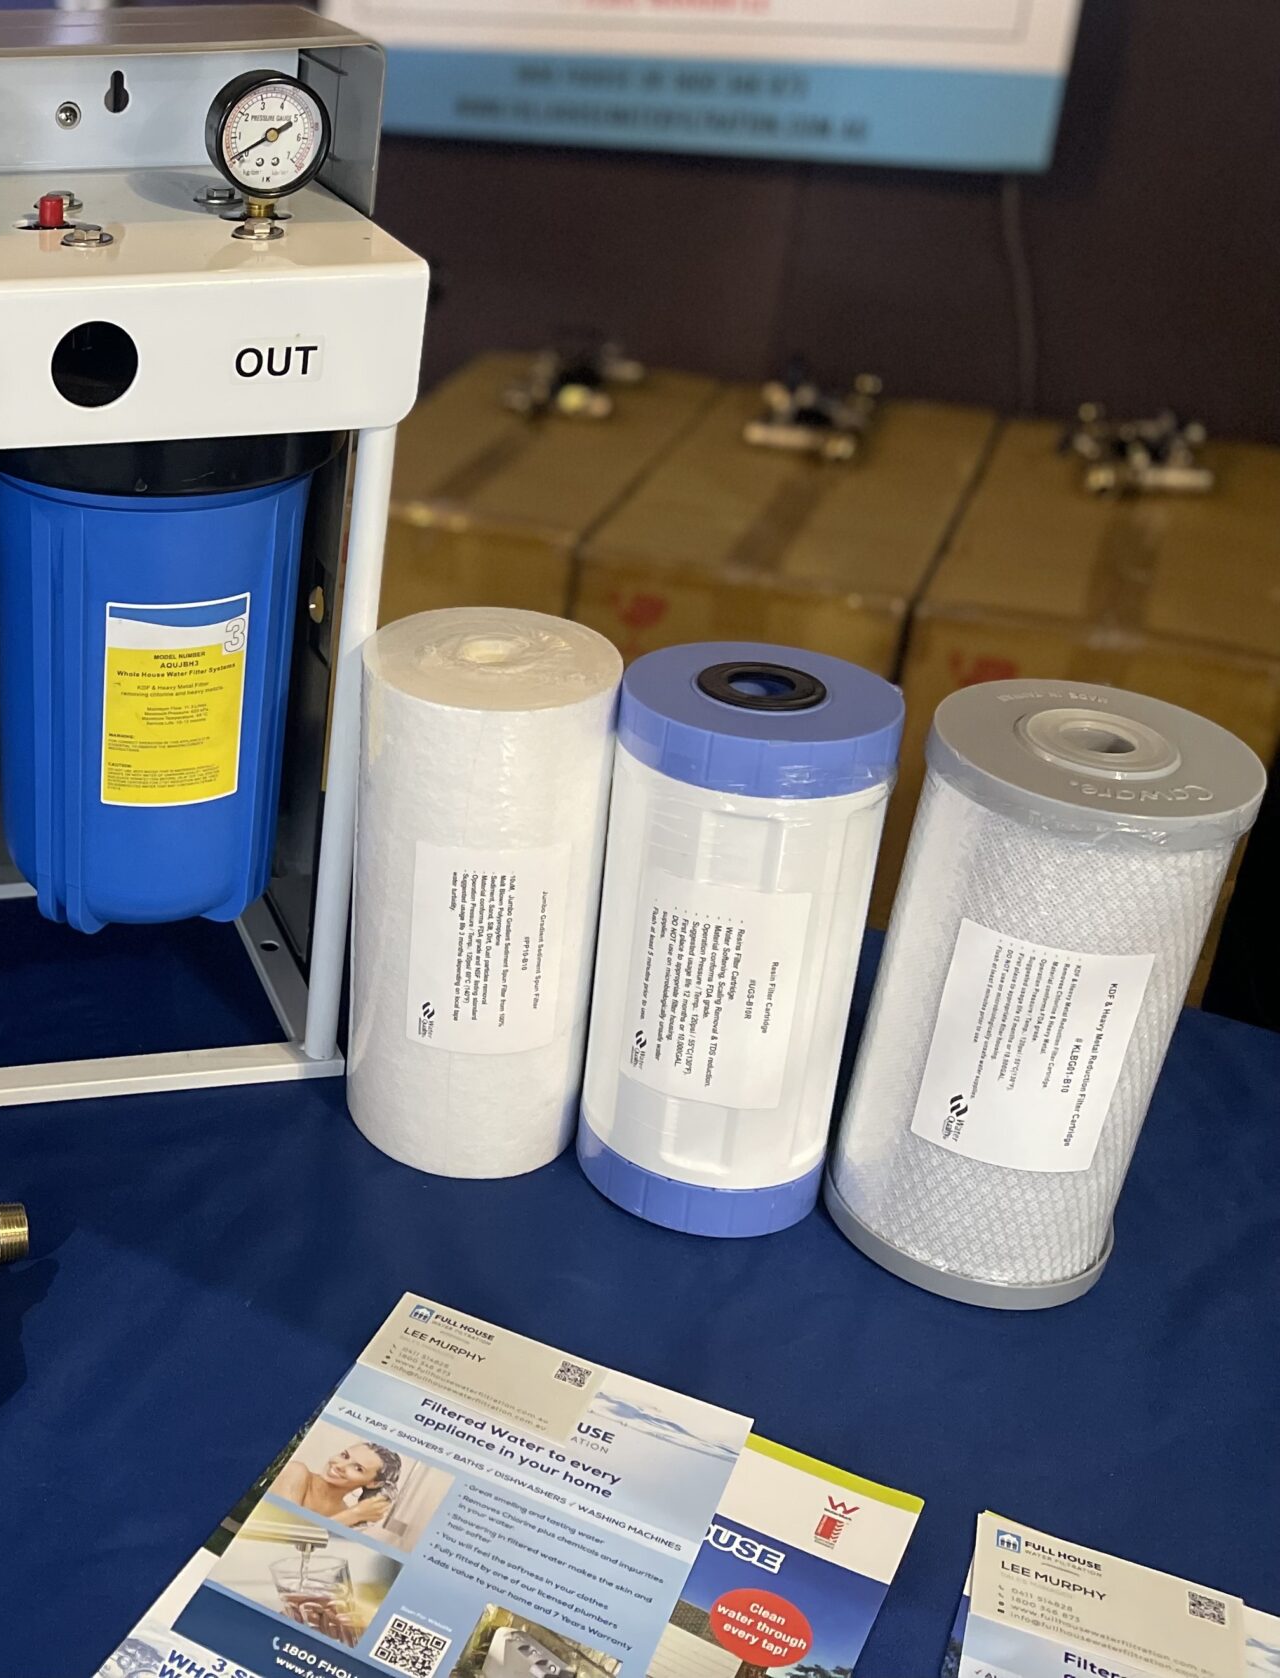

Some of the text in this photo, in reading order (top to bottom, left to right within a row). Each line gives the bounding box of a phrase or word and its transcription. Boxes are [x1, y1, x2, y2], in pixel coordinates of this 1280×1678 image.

[235, 345, 318, 378] OUT
[224, 617, 246, 653] 3
[117, 670, 140, 678] Whole
[166, 670, 187, 678] Water
[208, 662, 236, 674] Systems
[178, 651, 206, 659] NUMBER
[760, 961, 780, 1034] Resin Filter Cartridge
[1107, 983, 1119, 1000] KDF
[1095, 1008, 1111, 1032] Heavy
[1091, 1033, 1104, 1054] Metal
[1079, 1054, 1098, 1093] Reduction
[1074, 1093, 1087, 1113] Filter
[951, 1115, 965, 1143] Water
[1063, 1113, 1081, 1147] Cartridge
[403, 1327, 486, 1363] LEE MURPHY
[433, 1312, 495, 1343] FULL HOUSE
[420, 1397, 622, 1486] Filtered Water to every
[576, 1421, 616, 1445] USE
[414, 1413, 613, 1498] appliance in your home
[343, 1406, 682, 1552] ALL TAPS SHOWERS BATHS DISHWASHERS WASHING MACHINES
[468, 1485, 605, 1545] Great smelling and tasting water
[462, 1495, 664, 1584] Removes Chlorine plus chemicals and impurities
[706, 1522, 786, 1575] USE
[1024, 1540, 1102, 1572] FULL HOUSE
[444, 1532, 609, 1611] You will feel the softness in your clothes
[454, 1514, 653, 1604] Showering in filtered water makes the skin and
[433, 1544, 618, 1630] Fully fitted by one of our licensed plumbers
[1001, 1560, 1107, 1601] LEE MURPHY
[429, 1556, 633, 1652] Adds value to your home and 7 Years Warranty
[749, 1602, 786, 1626] Clean
[717, 1603, 808, 1651] water through
[723, 1622, 789, 1658] every tap!
[211, 1658, 228, 1673] 3
[282, 1642, 317, 1665] 1800
